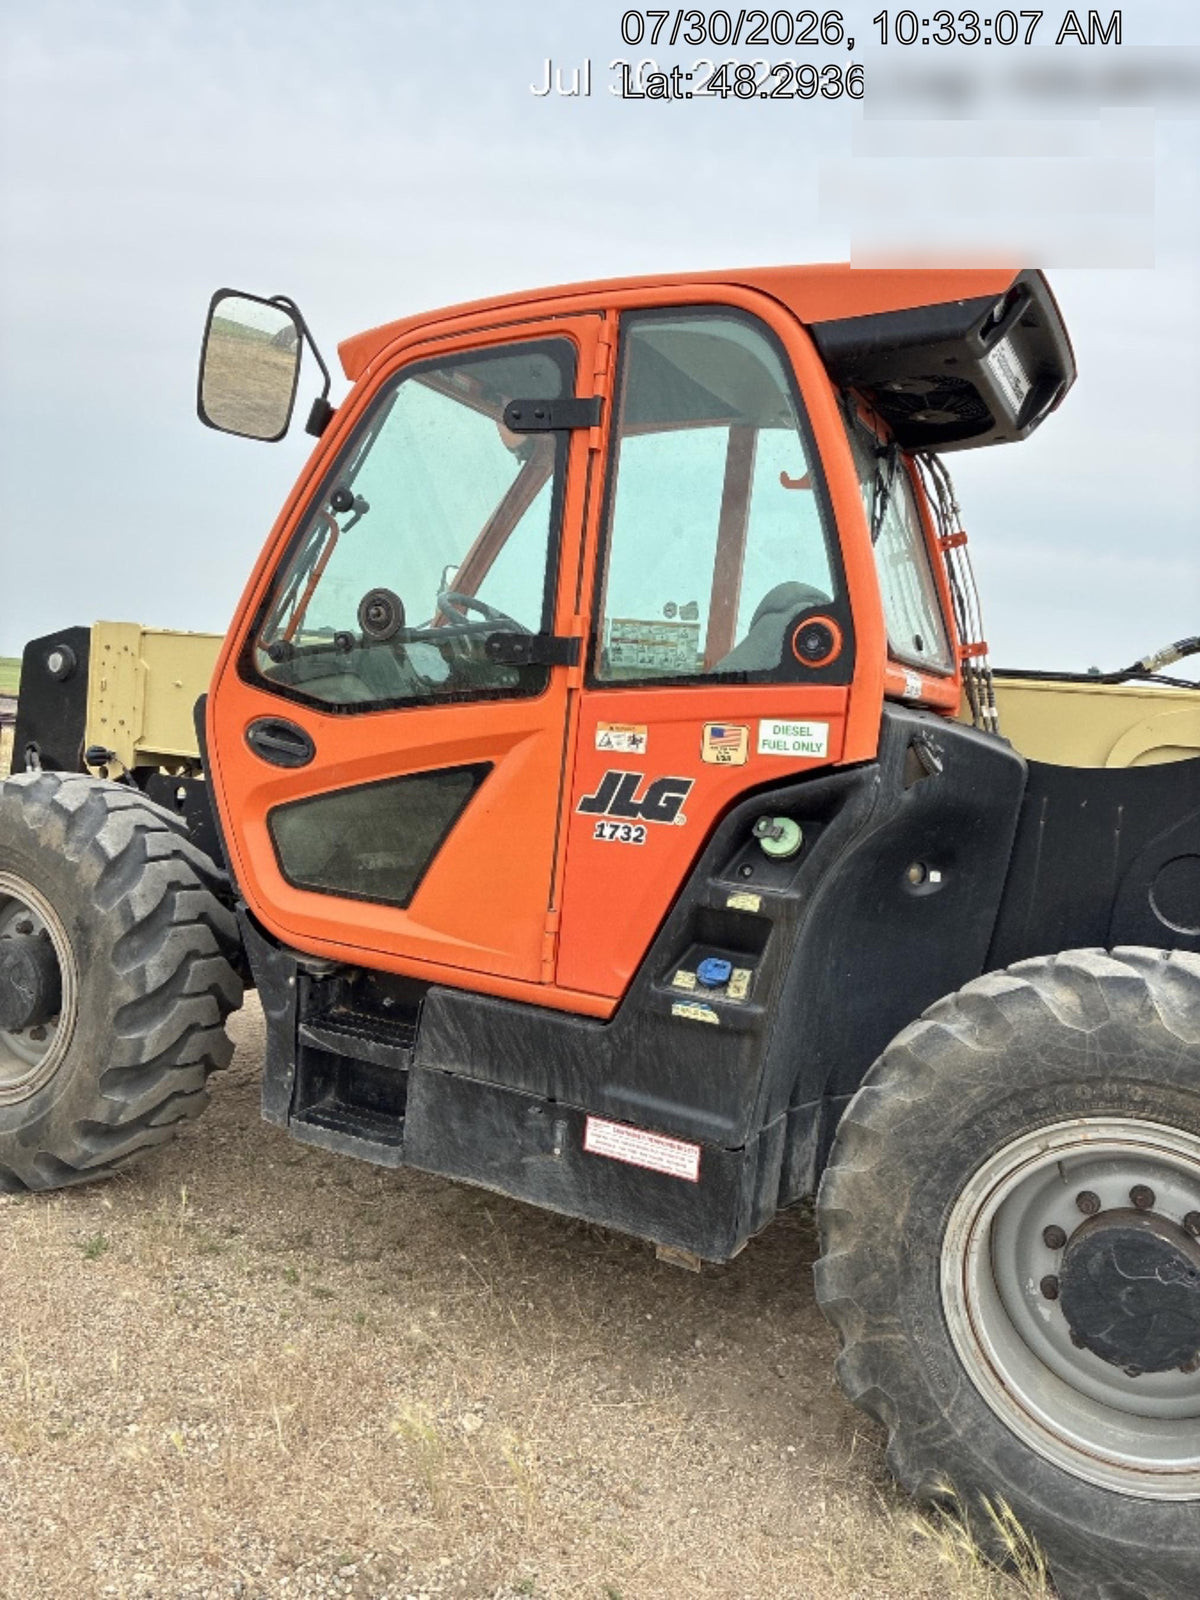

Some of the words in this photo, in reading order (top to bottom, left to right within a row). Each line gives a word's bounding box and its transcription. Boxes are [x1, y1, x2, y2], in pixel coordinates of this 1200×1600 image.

[772, 724, 813, 737] DIESEL
[761, 739, 790, 751] FUEL
[792, 740, 823, 753] ONLY
[576, 769, 695, 824] JLG
[593, 822, 647, 845] 1732
